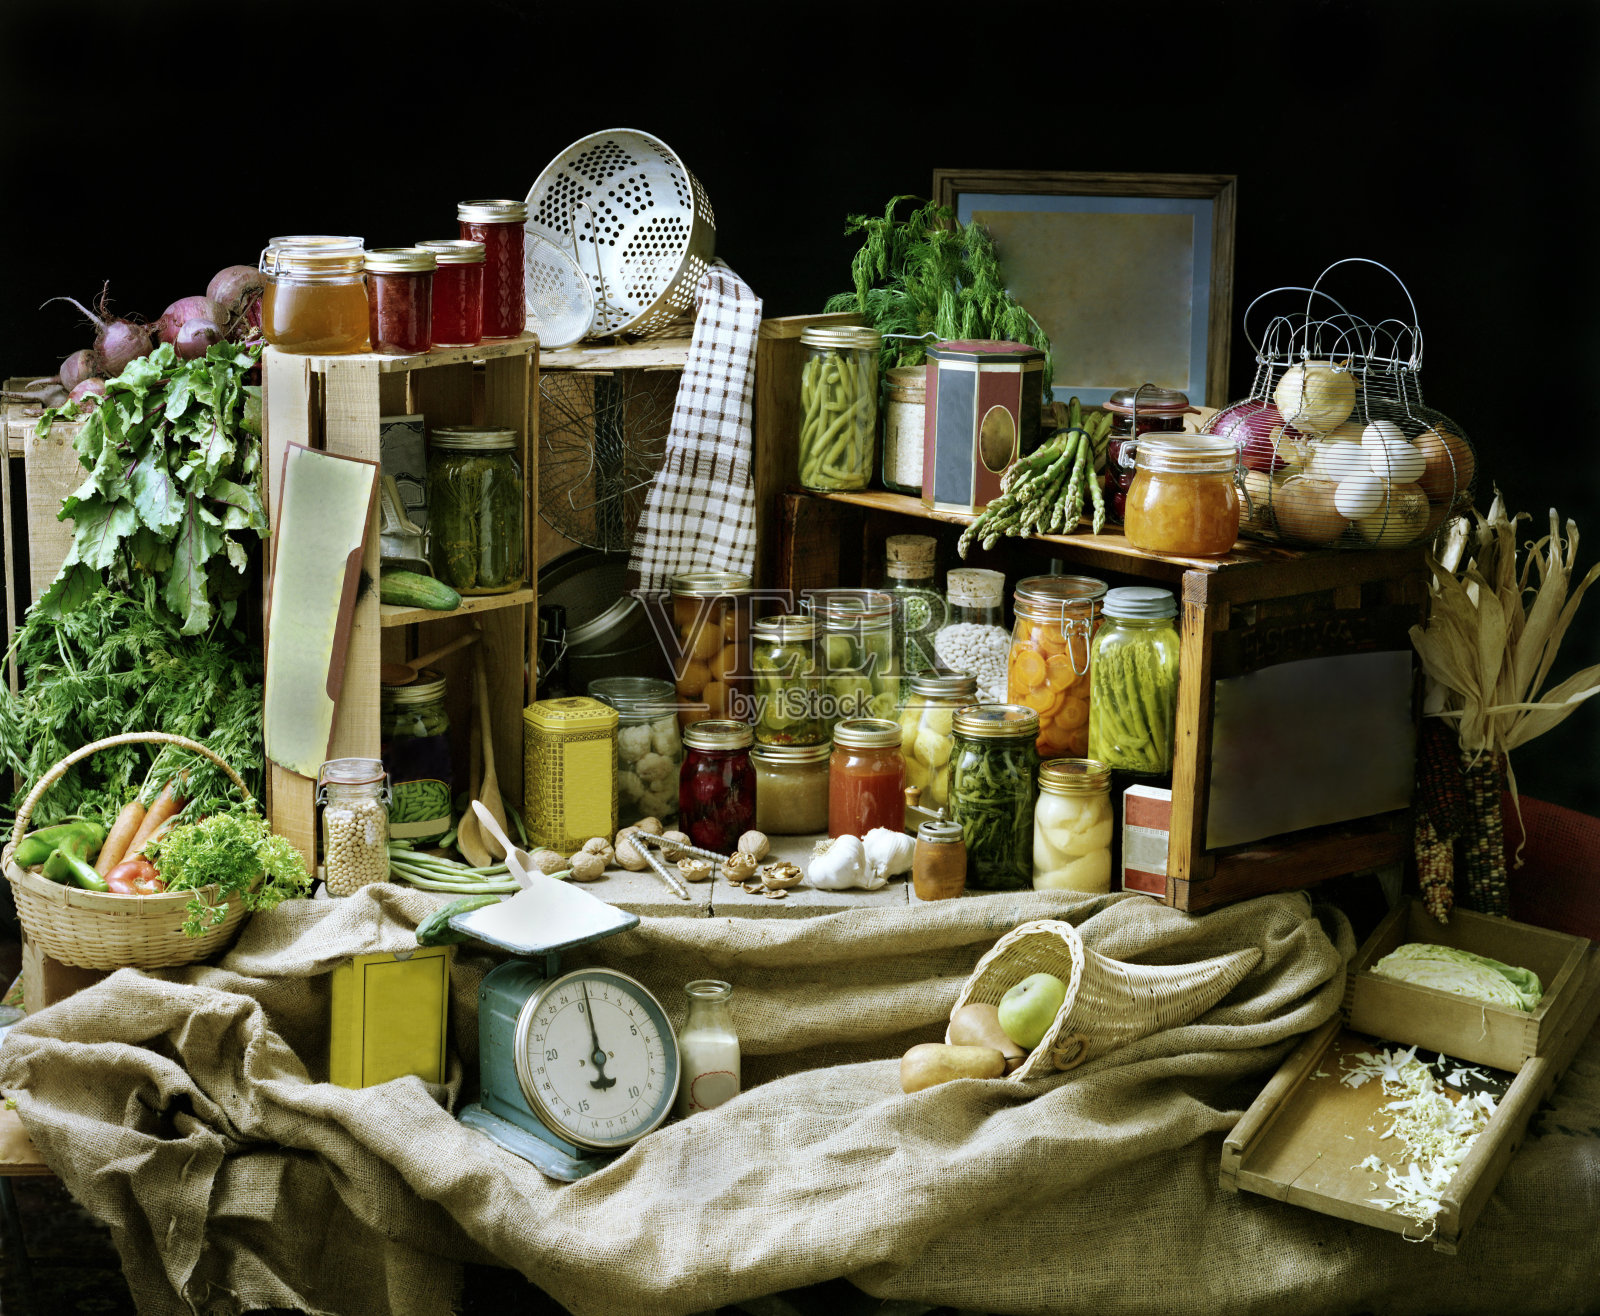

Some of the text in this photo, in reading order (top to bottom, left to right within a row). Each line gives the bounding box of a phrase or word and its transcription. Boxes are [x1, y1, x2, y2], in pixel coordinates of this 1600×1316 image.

[560, 996, 569, 1004] 24
[548, 1005, 557, 1014] 23
[577, 1002, 585, 1013] 0
[540, 1018, 549, 1026] 22
[630, 1024, 637, 1036] 5
[535, 1034, 544, 1042] 21
[545, 1048, 558, 1061] 20
[536, 1066, 545, 1075] 19
[542, 1082, 551, 1091] 18
[628, 1085, 640, 1099] 10
[551, 1097, 558, 1105] 17
[577, 1099, 590, 1113] 15
[563, 1108, 571, 1117] 16
[631, 1108, 639, 1117] 11
[591, 1120, 599, 1129] 14
[606, 1120, 614, 1129] 13
[619, 1116, 628, 1124] 12
